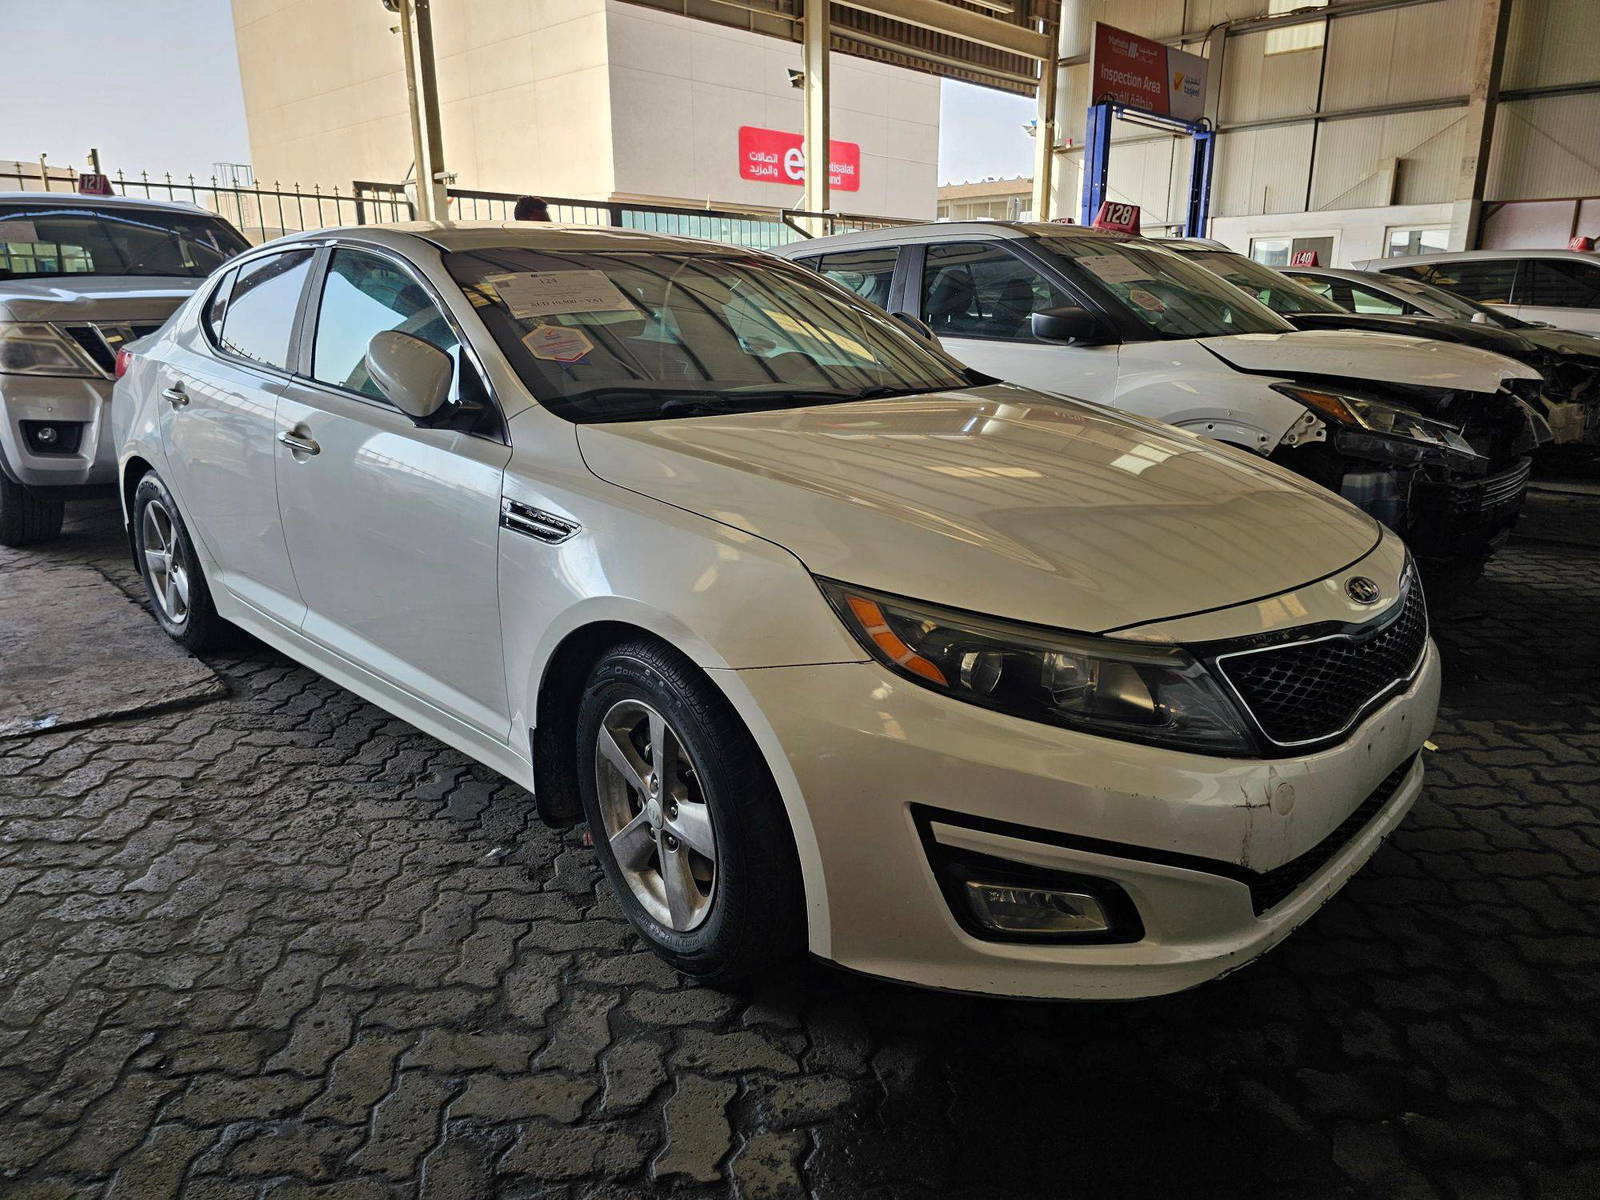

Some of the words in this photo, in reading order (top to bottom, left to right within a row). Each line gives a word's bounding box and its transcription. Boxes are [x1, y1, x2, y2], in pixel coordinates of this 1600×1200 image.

[1101, 64, 1142, 87] Inspection
[1143, 76, 1161, 94] Area
[749, 151, 779, 164] اتصالات
[784, 142, 805, 180] e
[750, 164, 779, 177] والمزيد
[1106, 204, 1132, 225] 128
[1296, 252, 1311, 264] 140
